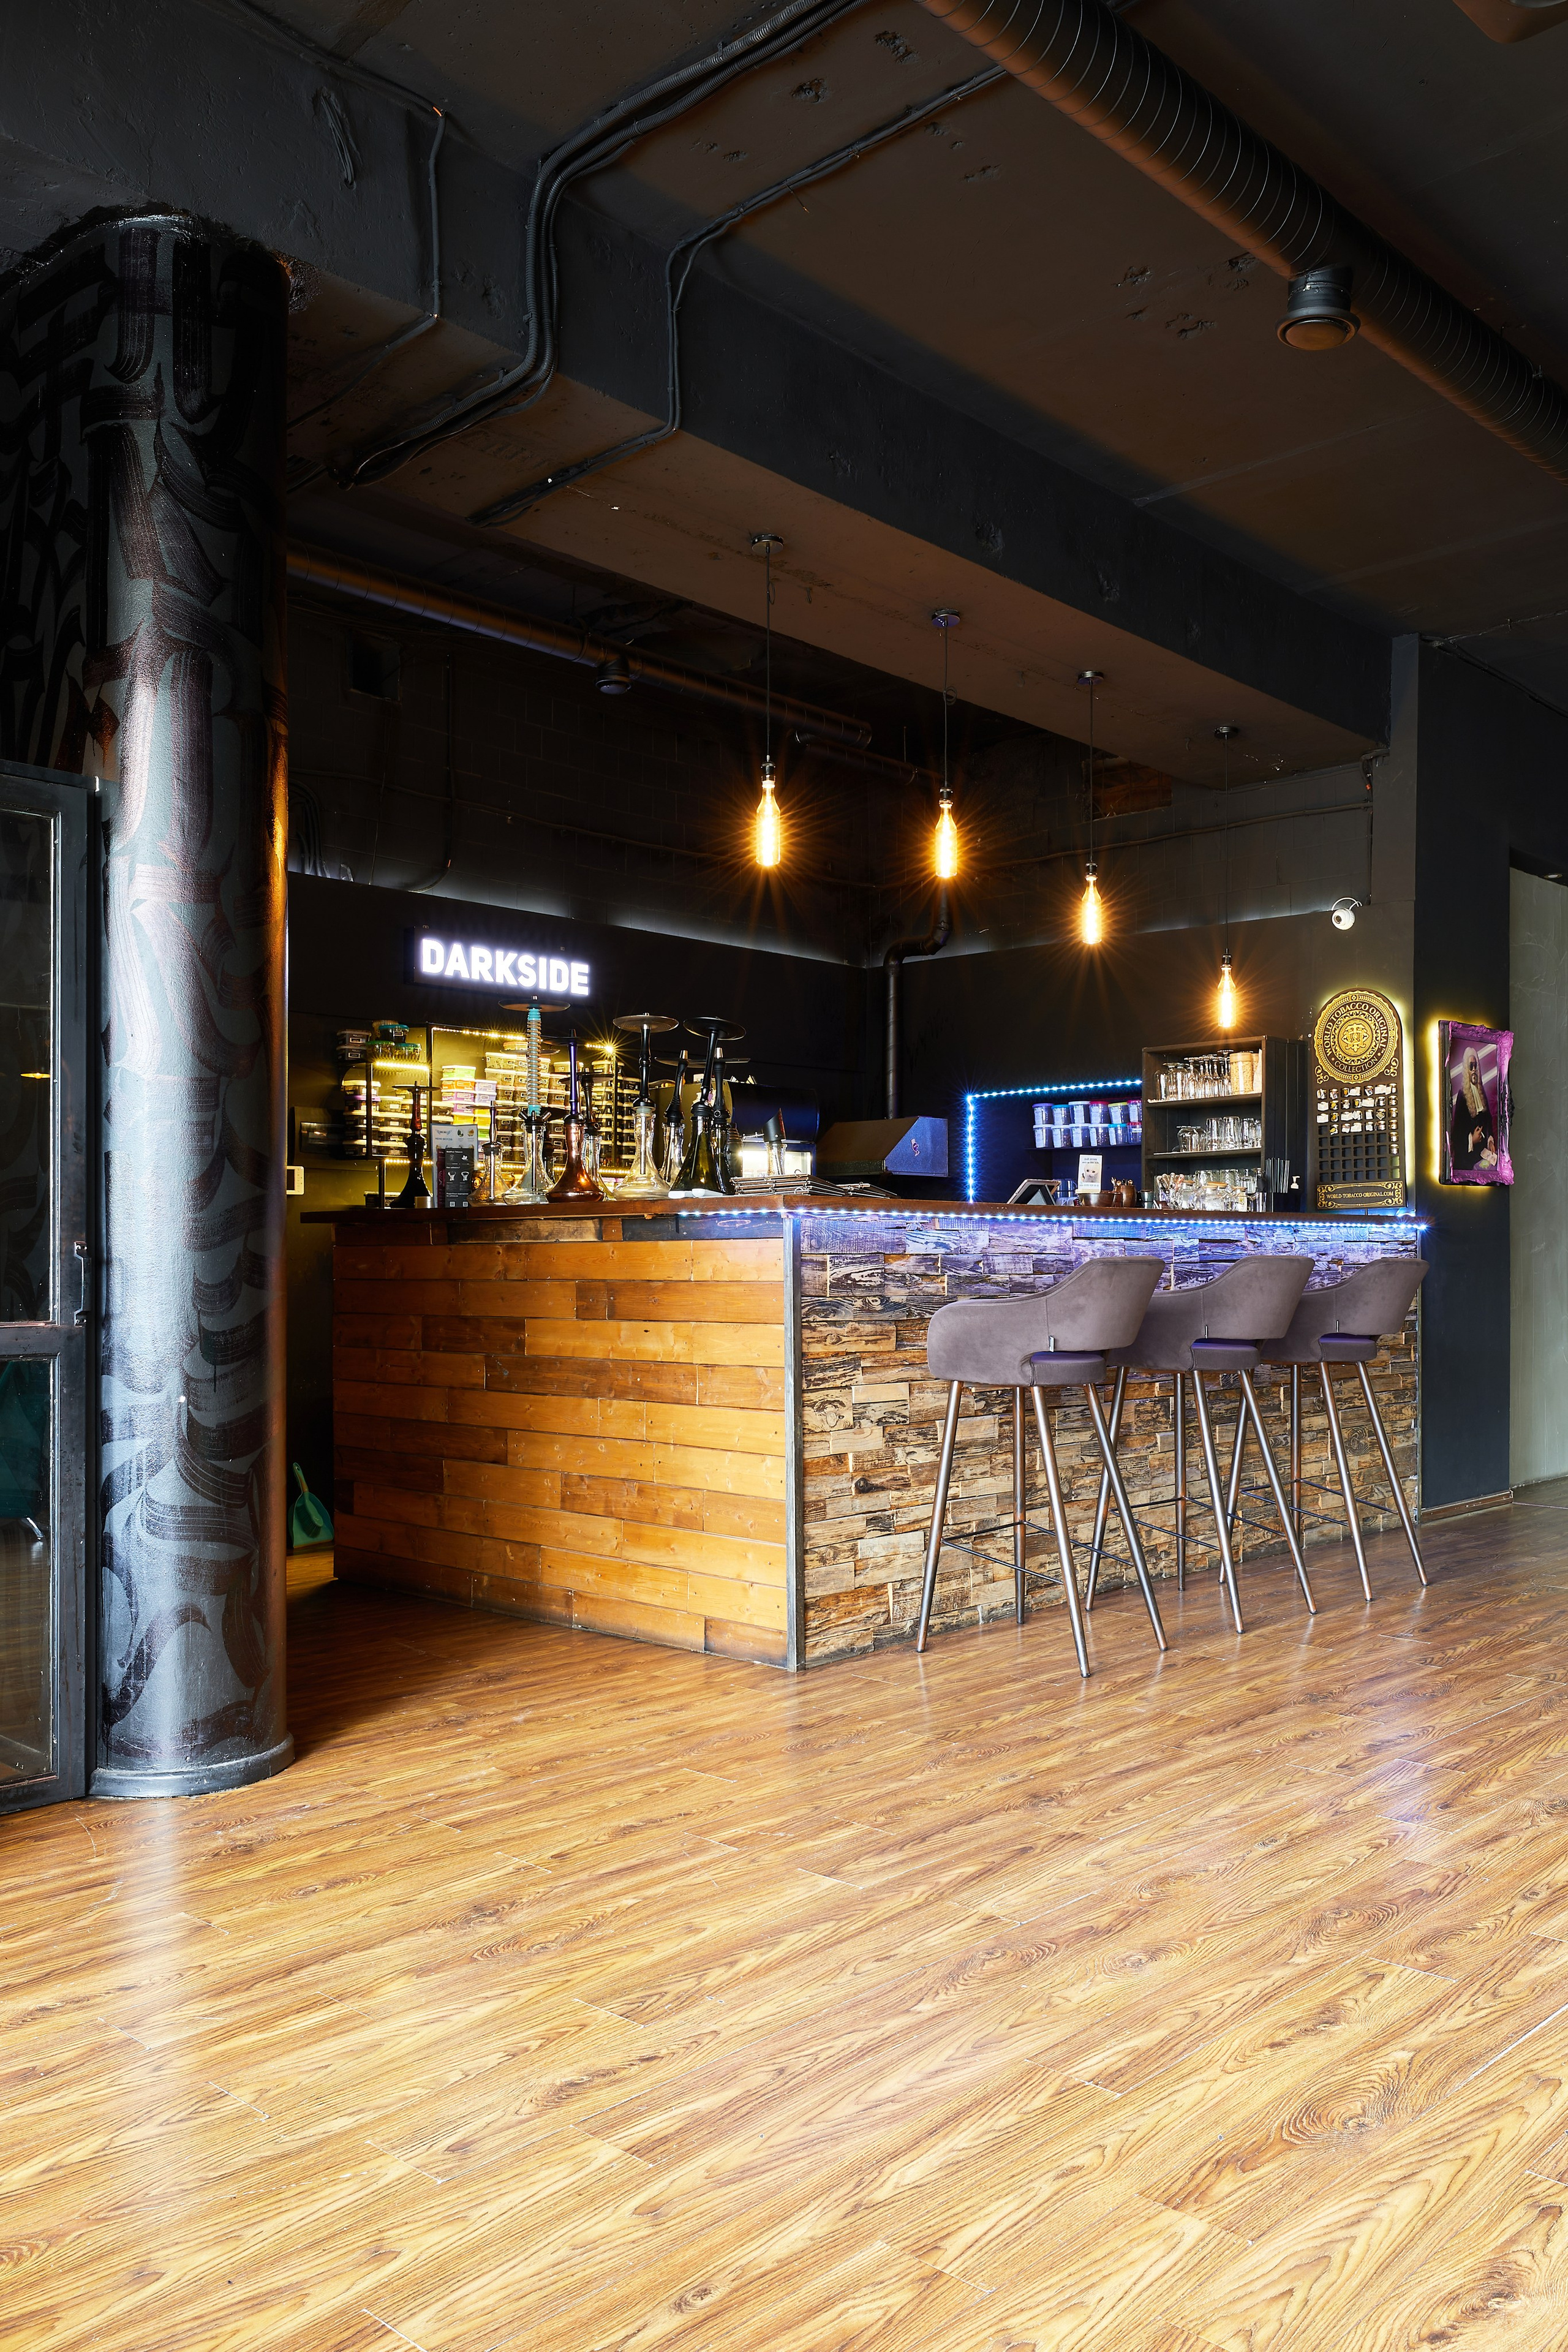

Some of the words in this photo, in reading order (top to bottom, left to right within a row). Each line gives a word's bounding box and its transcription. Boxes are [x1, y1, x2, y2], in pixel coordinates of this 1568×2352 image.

[422, 938, 589, 995] DARKSIDE
[1324, 1022, 1333, 1057] WORLD
[1330, 1002, 1369, 1022] TOBACCO
[1334, 1057, 1378, 1072] COLLECTION
